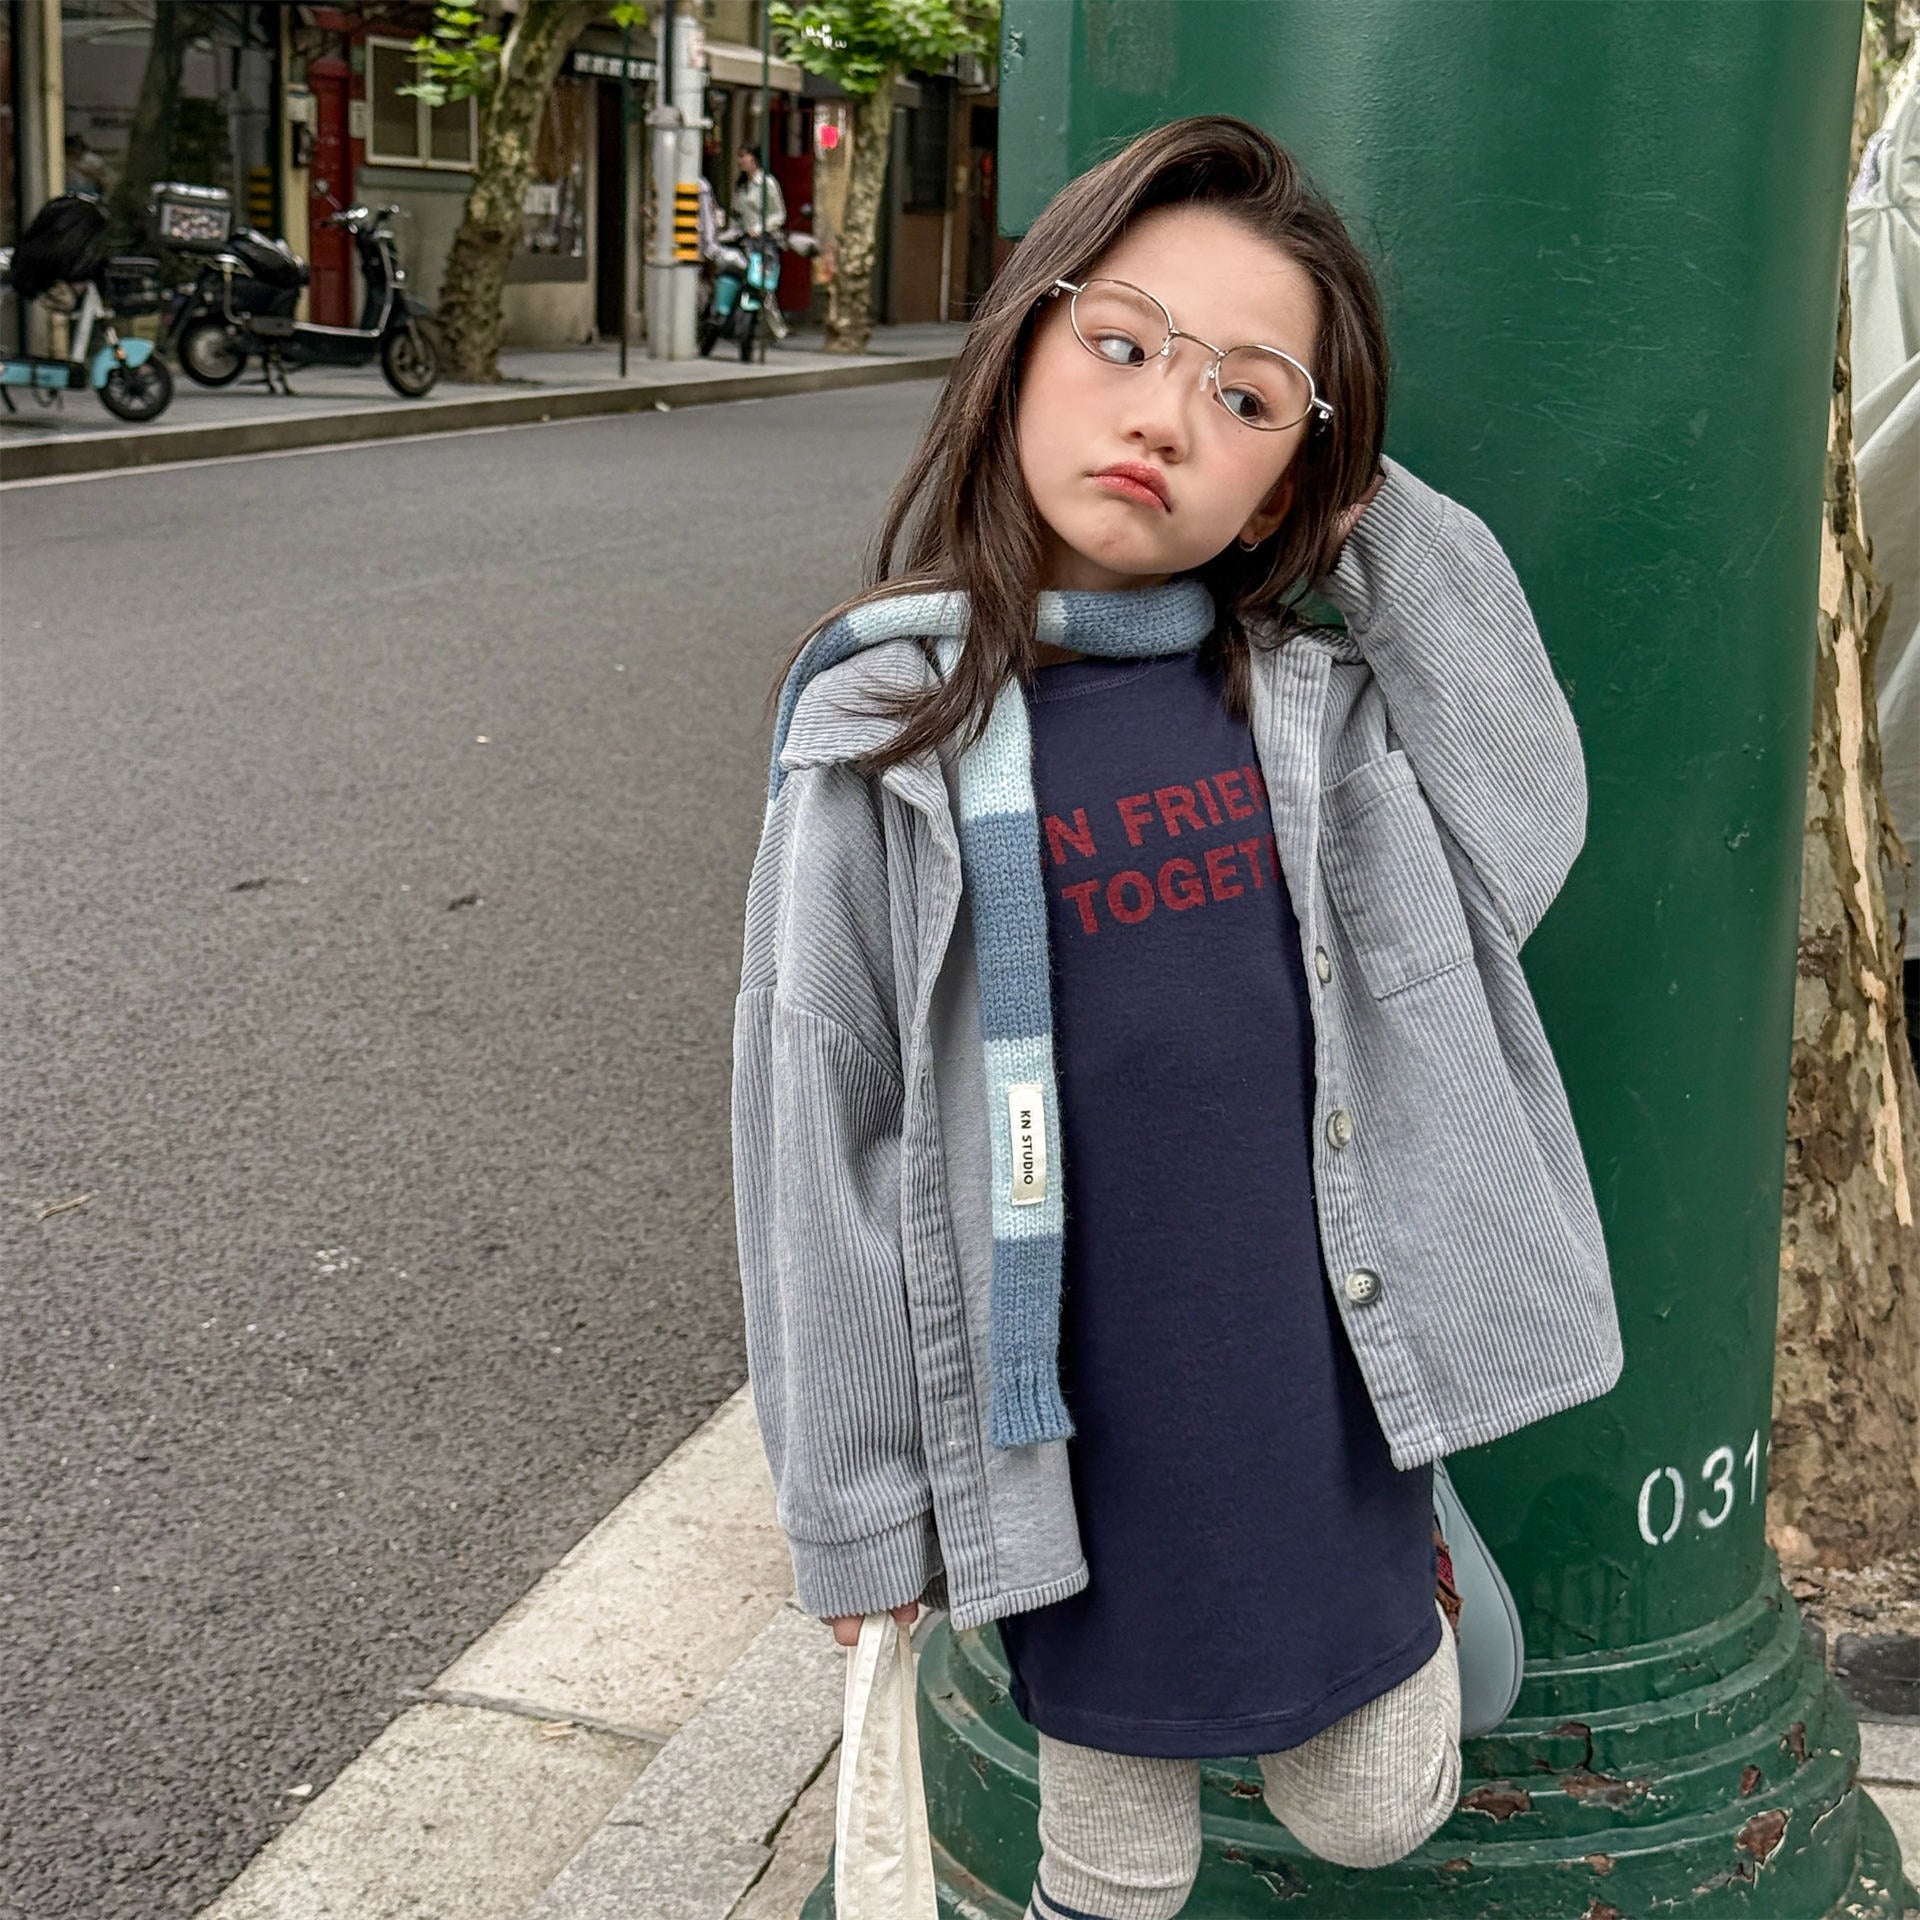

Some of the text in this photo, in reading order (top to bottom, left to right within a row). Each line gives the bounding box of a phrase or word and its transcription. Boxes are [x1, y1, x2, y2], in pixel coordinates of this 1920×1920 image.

[1040, 807, 1097, 869] N
[1020, 1109, 1034, 1185] KN STUDIO
[1637, 1428, 1772, 1546] 031
